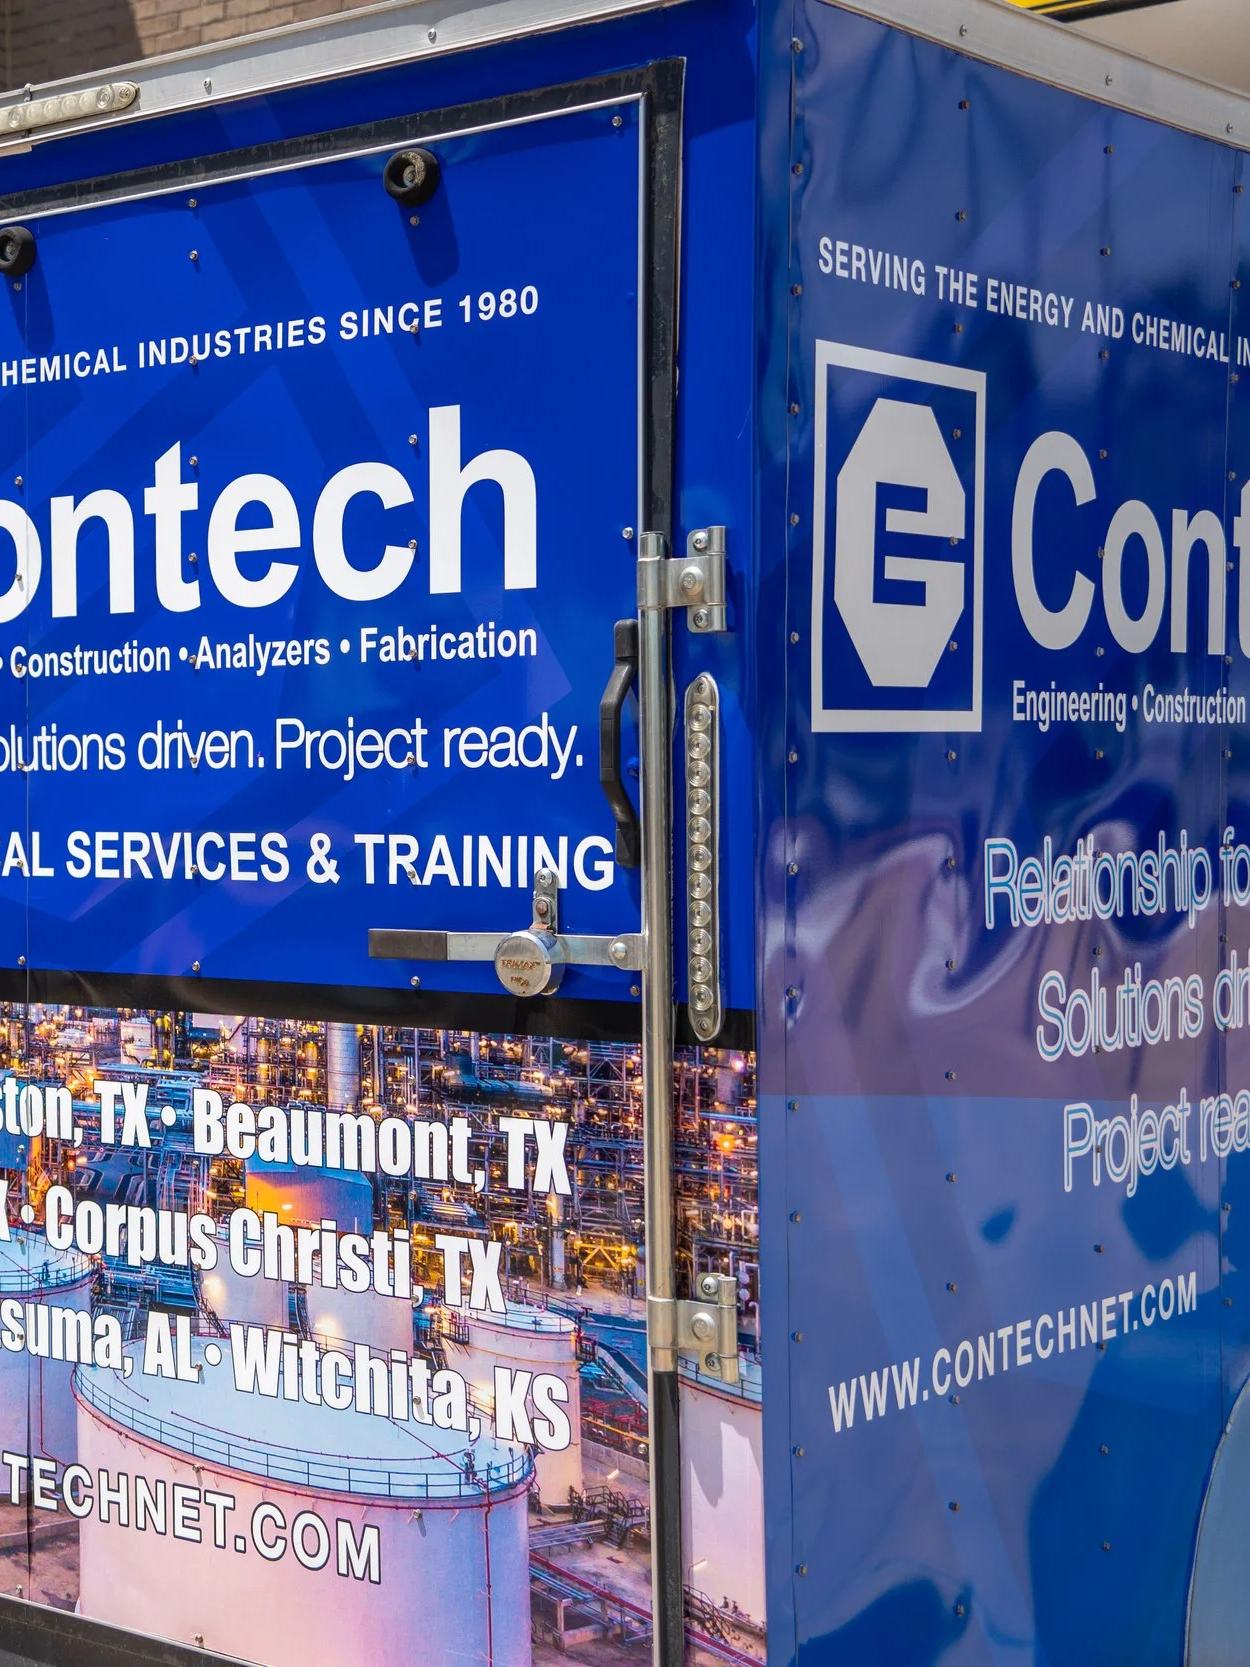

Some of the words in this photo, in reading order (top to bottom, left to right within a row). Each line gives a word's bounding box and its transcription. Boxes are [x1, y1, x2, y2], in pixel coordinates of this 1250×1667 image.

[139, 316, 326, 368] INDUSTRIES
[339, 298, 443, 340] SINCE
[458, 285, 539, 323] 1980
[818, 236, 926, 296] SERVING
[935, 265, 978, 309] THE
[986, 278, 1074, 329] ENERGY
[1081, 301, 1125, 340] AND
[1131, 312, 1229, 364] CHEMICAL
[10, 641, 171, 678] Construction
[195, 633, 330, 677] Analyzers
[360, 621, 537, 663] Fabrication
[138, 719, 265, 771] driven.
[276, 716, 428, 781] Project
[443, 711, 584, 780] ready.
[1012, 679, 1126, 733] Engineering
[1142, 682, 1246, 724] Construction
[66, 830, 289, 882] SERVICES
[306, 832, 340, 885] &
[354, 833, 614, 891] TRAINING
[984, 829, 1212, 929] Relationship
[1036, 962, 1204, 1062] Solutions
[94, 1079, 151, 1147] TX
[193, 1088, 486, 1193] Beaumont,
[500, 1116, 573, 1195] TX
[1063, 1087, 1191, 1198] Project
[46, 1186, 218, 1271] Corpus
[229, 1207, 424, 1308] Christi,
[435, 1235, 507, 1314] TX
[143, 1311, 199, 1383] AL
[230, 1322, 482, 1442] Witchita,
[494, 1365, 572, 1452] KS
[828, 1271, 1198, 1433] WWW.CONTECHNET.COM
